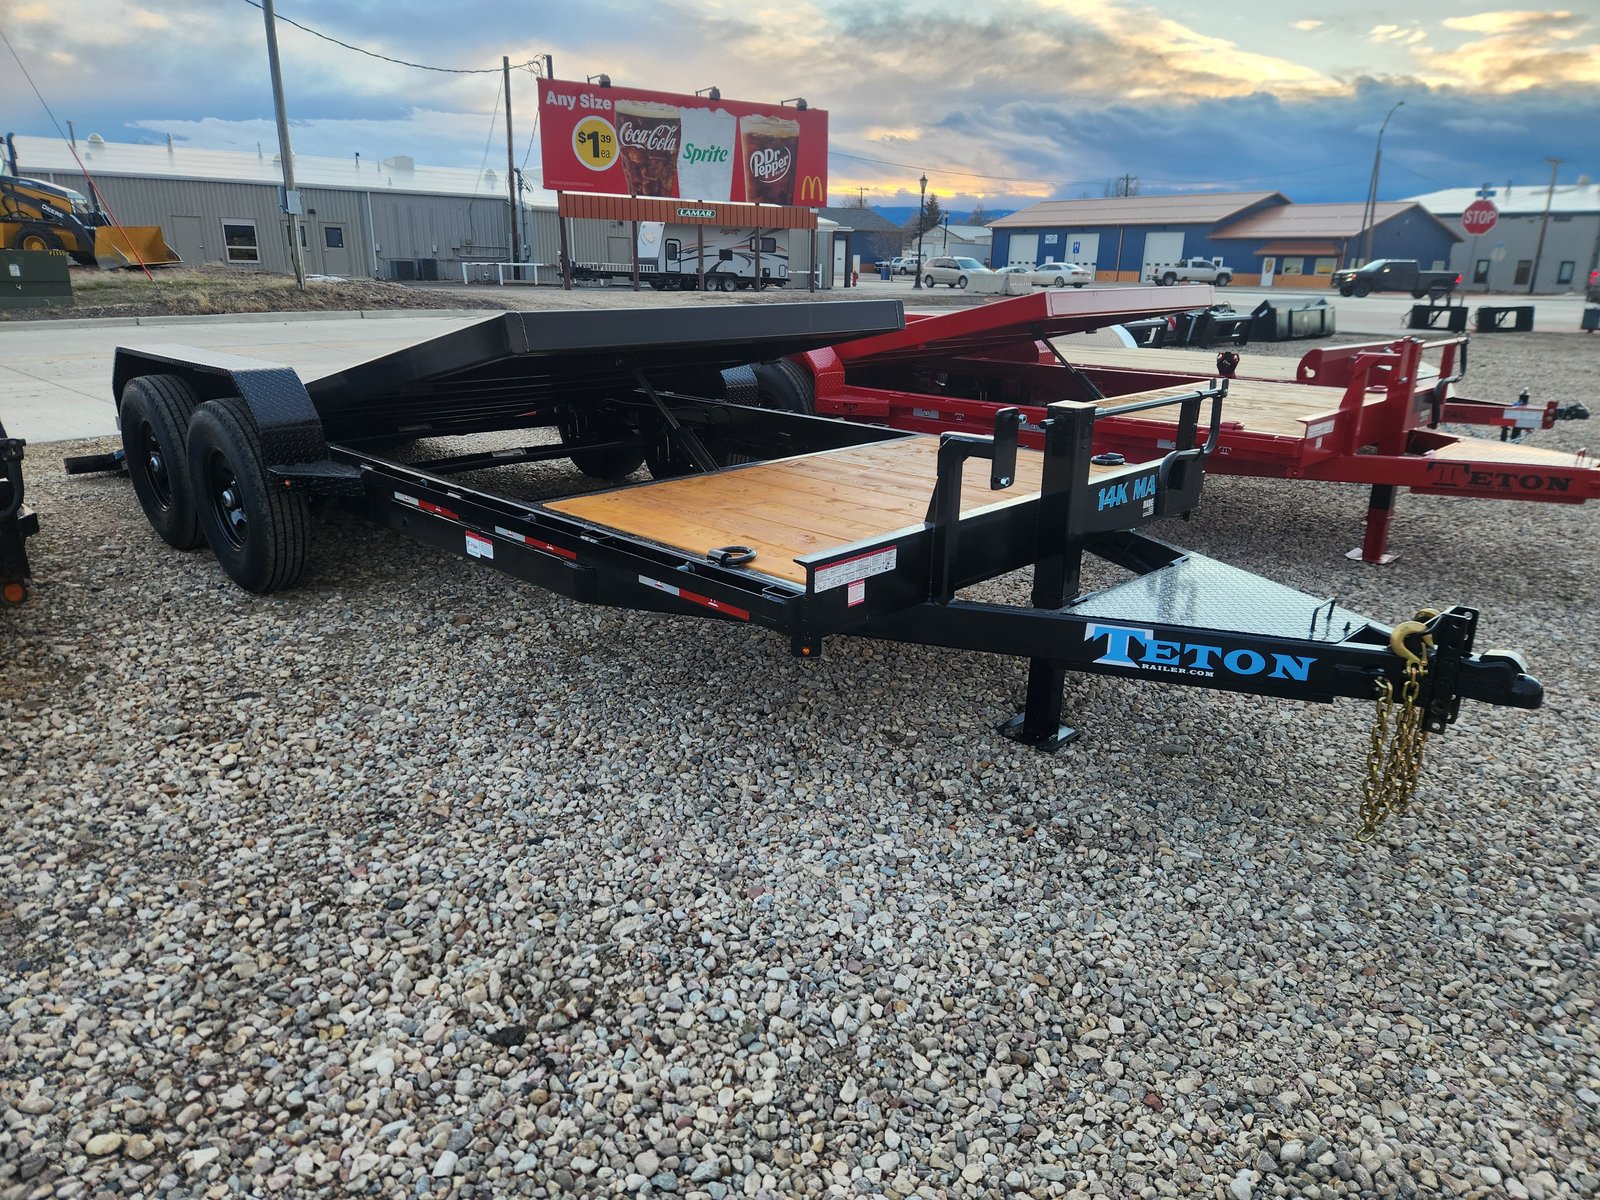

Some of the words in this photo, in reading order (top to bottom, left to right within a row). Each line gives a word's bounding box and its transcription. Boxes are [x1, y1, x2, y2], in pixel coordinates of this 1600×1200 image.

[546, 90, 576, 110] Any
[580, 93, 612, 110] Size
[683, 143, 728, 164] Sprite
[764, 148, 781, 164] Dr
[750, 151, 789, 179] Pepper
[41, 203, 65, 219] DEERE
[680, 209, 712, 217] LAMAR
[1464, 210, 1496, 224] STOP
[1427, 461, 1574, 492] TETON
[1098, 482, 1129, 511] 14K
[1133, 474, 1159, 500] MA
[1084, 622, 1319, 682] TETON
